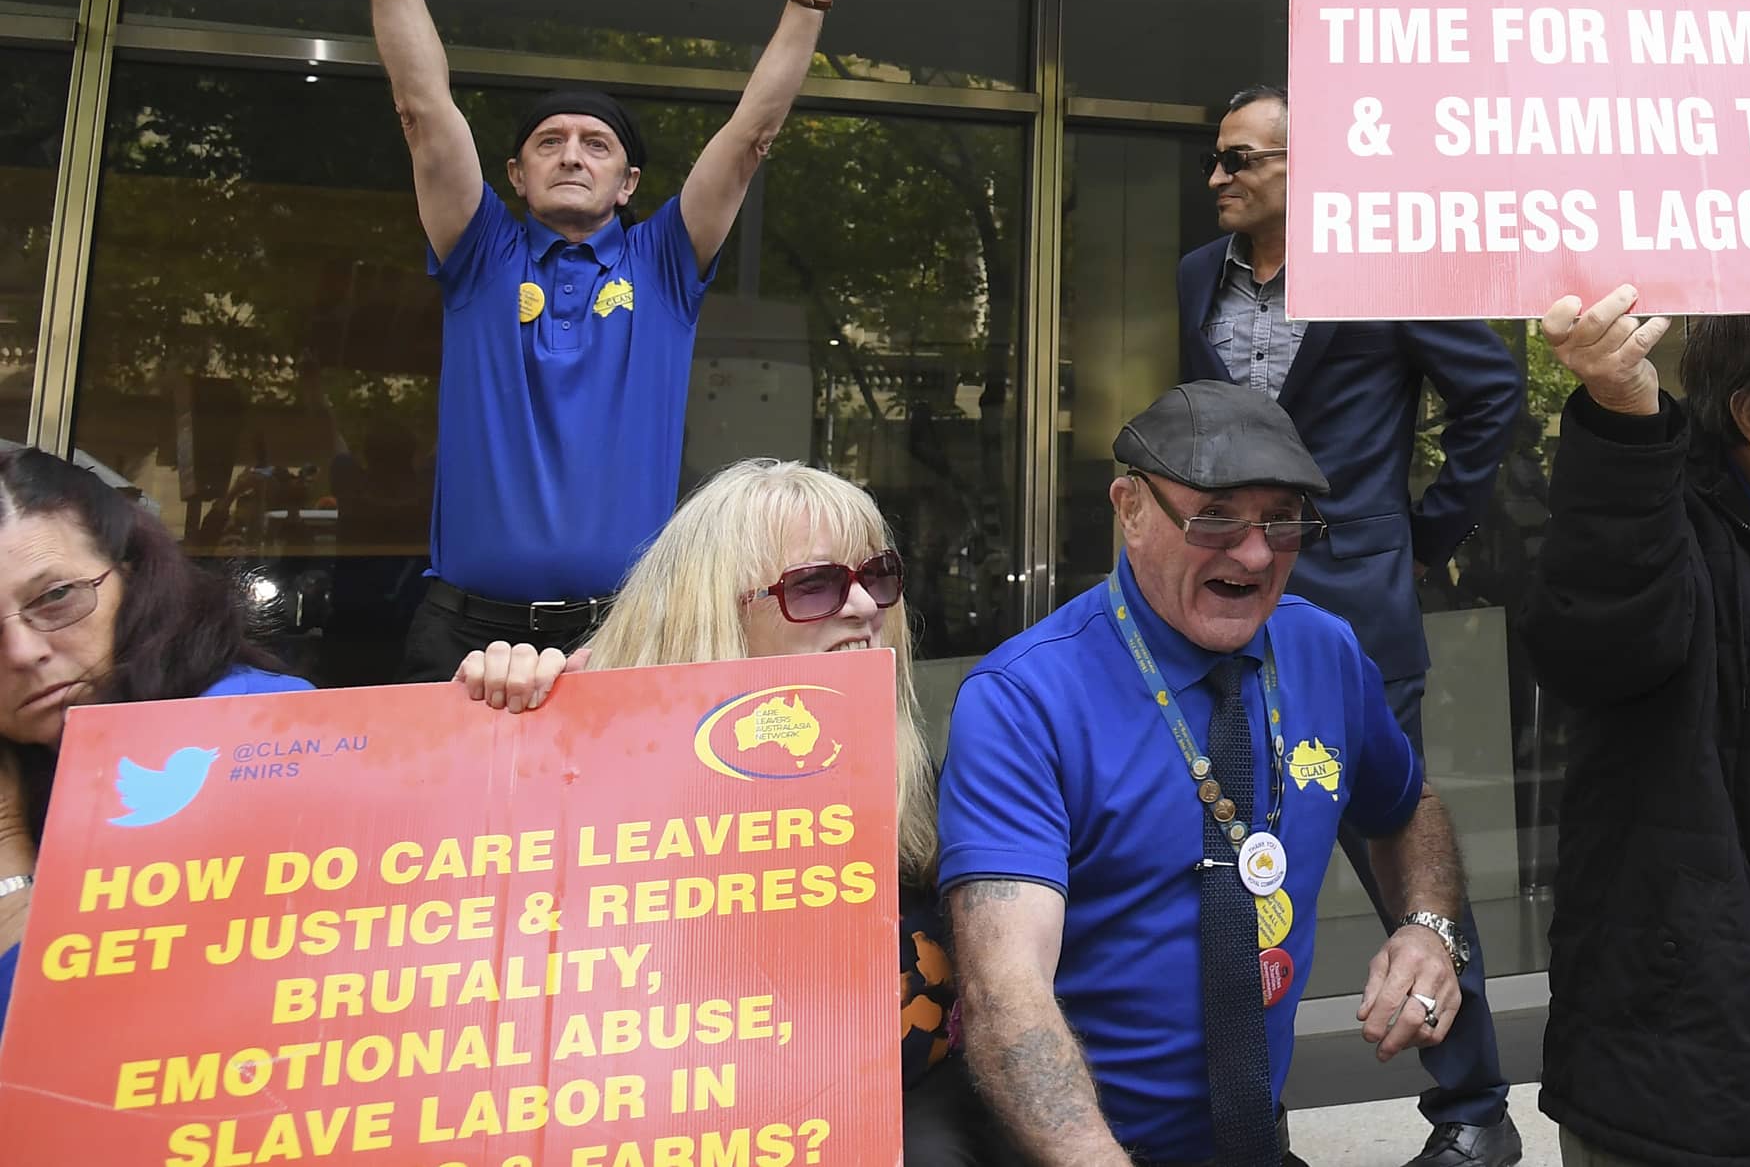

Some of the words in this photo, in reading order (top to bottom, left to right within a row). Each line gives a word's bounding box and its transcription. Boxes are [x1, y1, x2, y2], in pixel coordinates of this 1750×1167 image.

[1319, 8, 1470, 64] TIME
[1492, 8, 1609, 64] FOR
[1347, 97, 1392, 156] &
[1435, 97, 1717, 156] SHAMING
[1312, 190, 1599, 254] REDRESS
[230, 762, 300, 782] #NIRS
[233, 736, 368, 762] @CLAN_AU
[1301, 764, 1327, 778] CLAN
[79, 855, 245, 913] HOW
[264, 846, 358, 896] DO
[380, 828, 555, 886] CARE
[578, 803, 855, 867] LEAVERS
[41, 926, 186, 983] GET
[206, 895, 497, 965] JUSTICE
[519, 891, 563, 934] &
[587, 862, 877, 928] REDRESS
[271, 943, 663, 1024] BRUTALITY,
[114, 1022, 537, 1109] EMOTIONAL
[553, 995, 794, 1057] ABUSE,
[165, 1100, 401, 1167] SLAVE
[418, 1074, 652, 1144] LABOR
[671, 1063, 737, 1112] IN
